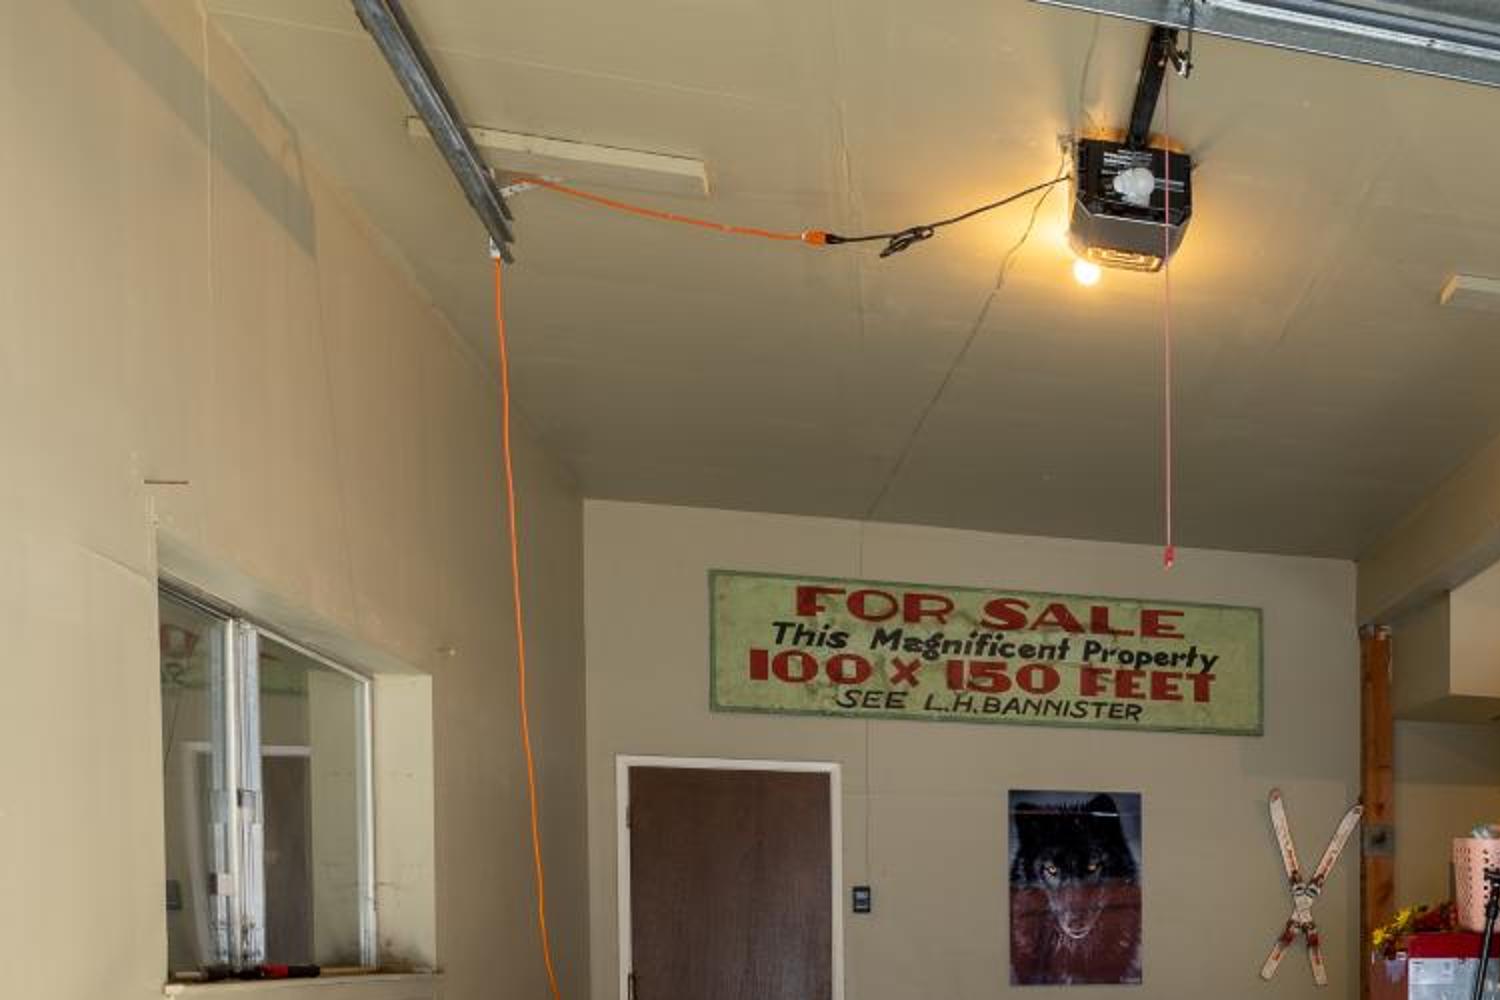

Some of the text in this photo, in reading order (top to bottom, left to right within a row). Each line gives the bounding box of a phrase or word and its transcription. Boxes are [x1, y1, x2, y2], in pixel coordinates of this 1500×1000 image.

[796, 585, 1185, 640] FOR SALE
[772, 621, 1219, 673] This Magnificent Property
[749, 648, 872, 685] 100
[946, 659, 1061, 695] 150
[1080, 664, 1216, 703] FEET
[836, 689, 910, 709] SEE
